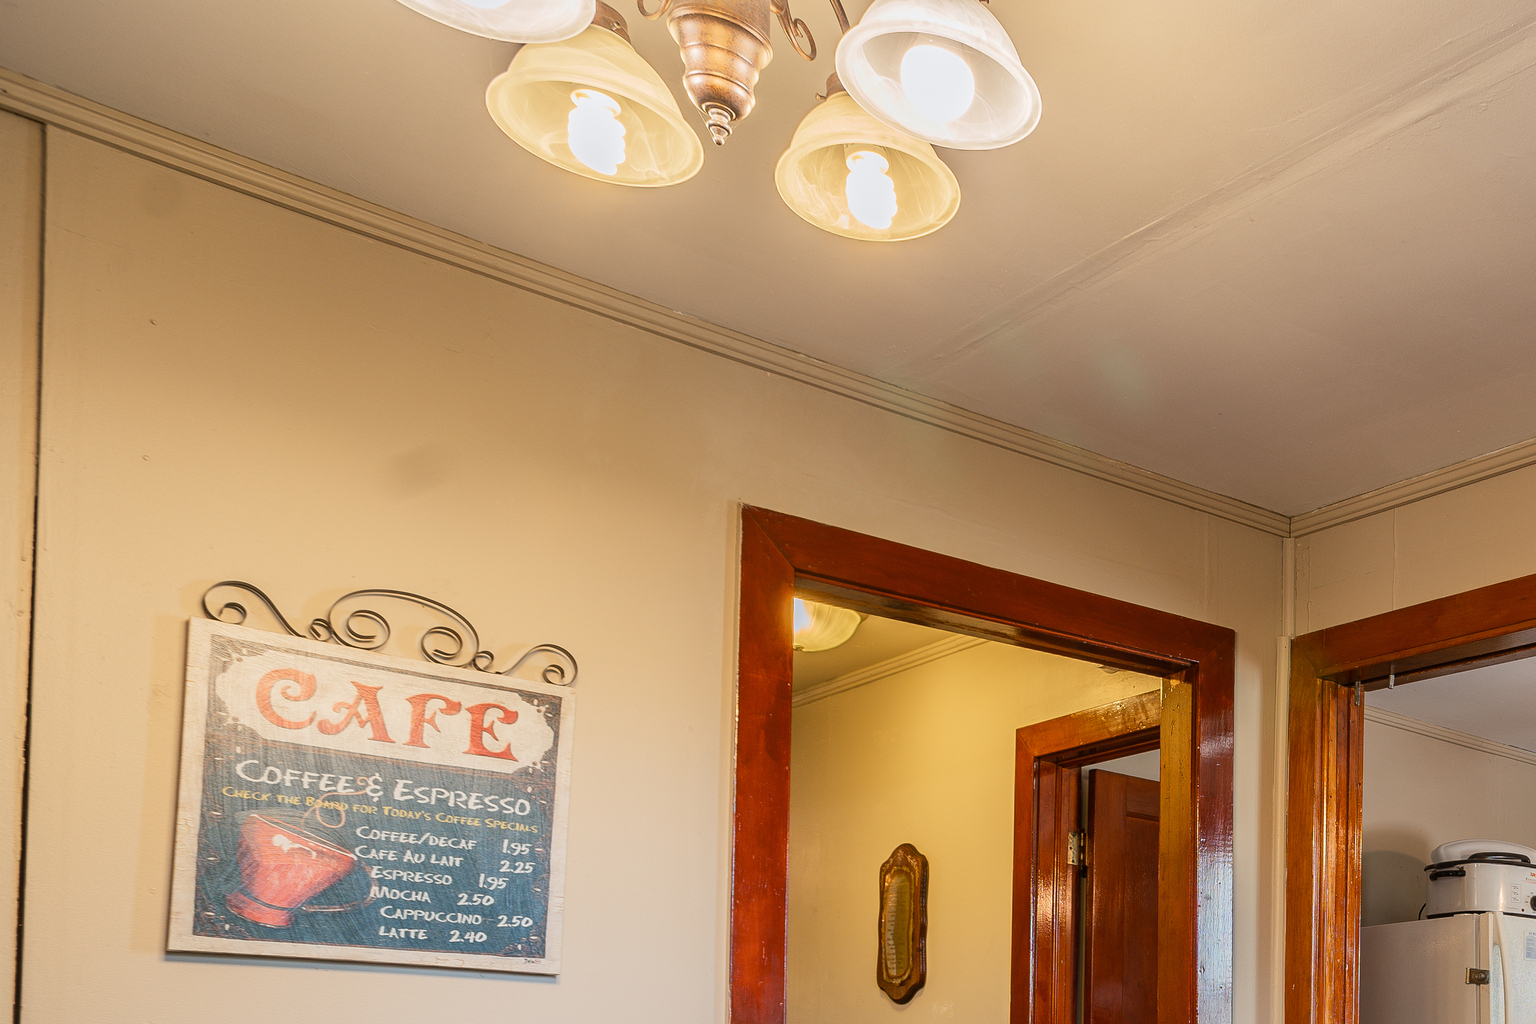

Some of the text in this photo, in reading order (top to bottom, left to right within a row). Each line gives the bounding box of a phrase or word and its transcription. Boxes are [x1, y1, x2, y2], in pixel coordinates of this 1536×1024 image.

[256, 668, 519, 762] CAFE
[236, 759, 531, 816] COFFEE & ESPRESSO
[222, 786, 539, 833] CHECK THE BOARD FOR TODAY'S COFFEE SPECIALS
[355, 826, 532, 856] COFFEE/DECAF 1.95
[355, 845, 536, 874] CAFE AU LAIT 2.25
[370, 865, 510, 890] ESPRESSO 1.95
[369, 884, 495, 906] MOCHA 2.50
[380, 905, 533, 928] CAPPUCCINO 2.50
[379, 926, 487, 943] LATTE 2.40
